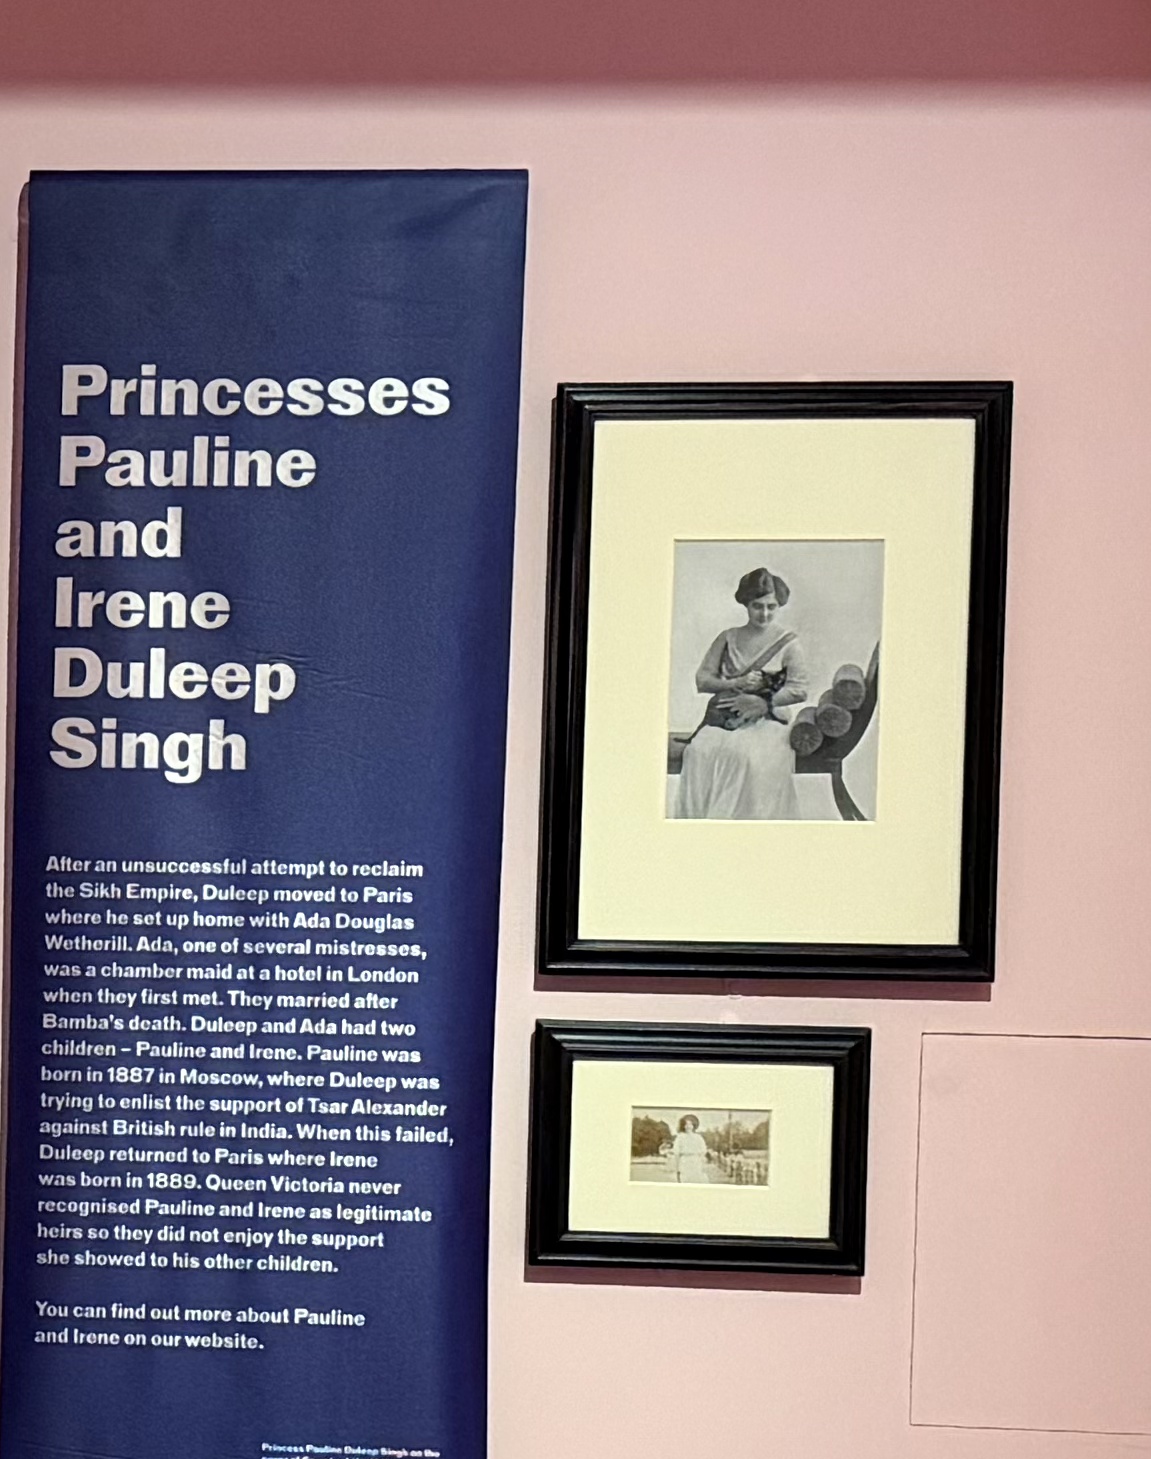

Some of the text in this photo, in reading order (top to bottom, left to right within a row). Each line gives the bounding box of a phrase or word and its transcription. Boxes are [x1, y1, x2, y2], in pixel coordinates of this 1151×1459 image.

[62, 364, 449, 415] Princesses
[60, 435, 316, 487] Pauline
[56, 506, 182, 558] and
[56, 576, 230, 629] Irene
[54, 647, 295, 713] Duleep
[50, 717, 245, 783] Singh
[46, 855, 423, 879] After an unsuccessful attempt to reclaim
[46, 882, 413, 904] the Sikh Empire, Duleep moved to Paris
[136, 936, 178, 955] Ada,
[183, 941, 216, 953] one
[221, 937, 238, 953] of
[244, 939, 311, 954] several
[316, 939, 427, 960] mistresses,
[44, 987, 398, 1010] when they first met. They married after
[129, 1015, 186, 1031] death.
[191, 1015, 257, 1035] Duleep
[262, 1018, 296, 1033] and
[300, 1017, 336, 1034] Ada
[342, 1019, 376, 1035] had
[381, 1020, 415, 1036] two
[42, 1040, 115, 1056] children
[137, 1041, 206, 1058] Pauline
[210, 1043, 244, 1059] and
[250, 1043, 302, 1060] Irene.
[307, 1044, 377, 1061] Pauline
[382, 1050, 421, 1062] was
[41, 1092, 447, 1116] trying to enlist the support of Tsar Alexander
[40, 1118, 453, 1146] against British rule in India. When this failed,
[40, 1144, 377, 1167] Duleep returned to Paris where Irene
[39, 1171, 401, 1194] was born in 1889. Queen Victoria never
[38, 1198, 432, 1224] recognised Pauline and Irene as legitimate
[37, 1248, 338, 1272] she showed to his other children.
[36, 1301, 365, 1325] You can find out more about Pauline
[35, 1327, 264, 1349] and Irene on our website.
